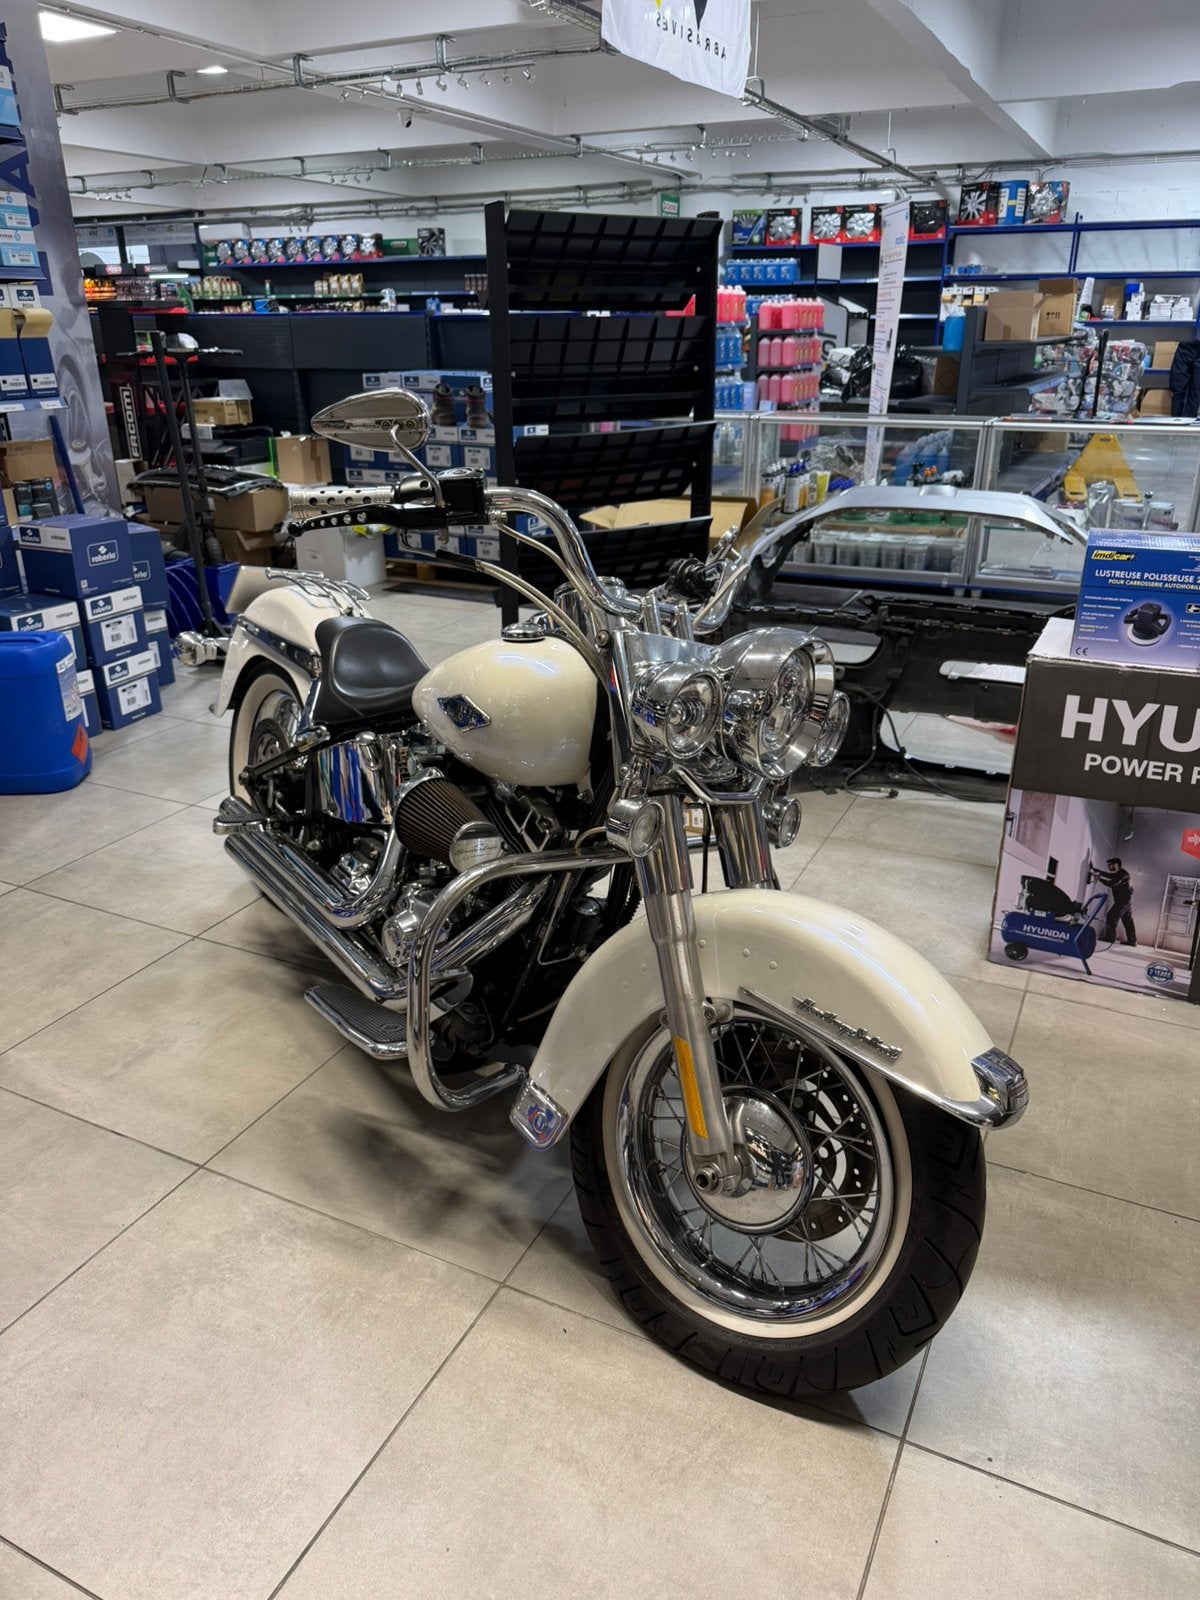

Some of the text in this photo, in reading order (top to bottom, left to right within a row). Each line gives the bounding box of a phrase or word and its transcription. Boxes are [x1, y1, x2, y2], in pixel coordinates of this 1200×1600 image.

[91, 551, 117, 563] roberlo
[1095, 569, 1141, 579] LUSTREUSE
[1143, 572, 1194, 583] POLISSEUSE
[1125, 580, 1163, 588] CARROSSERIE
[1083, 753, 1183, 783] POWER
[1023, 924, 1070, 940] HYUNDAI
